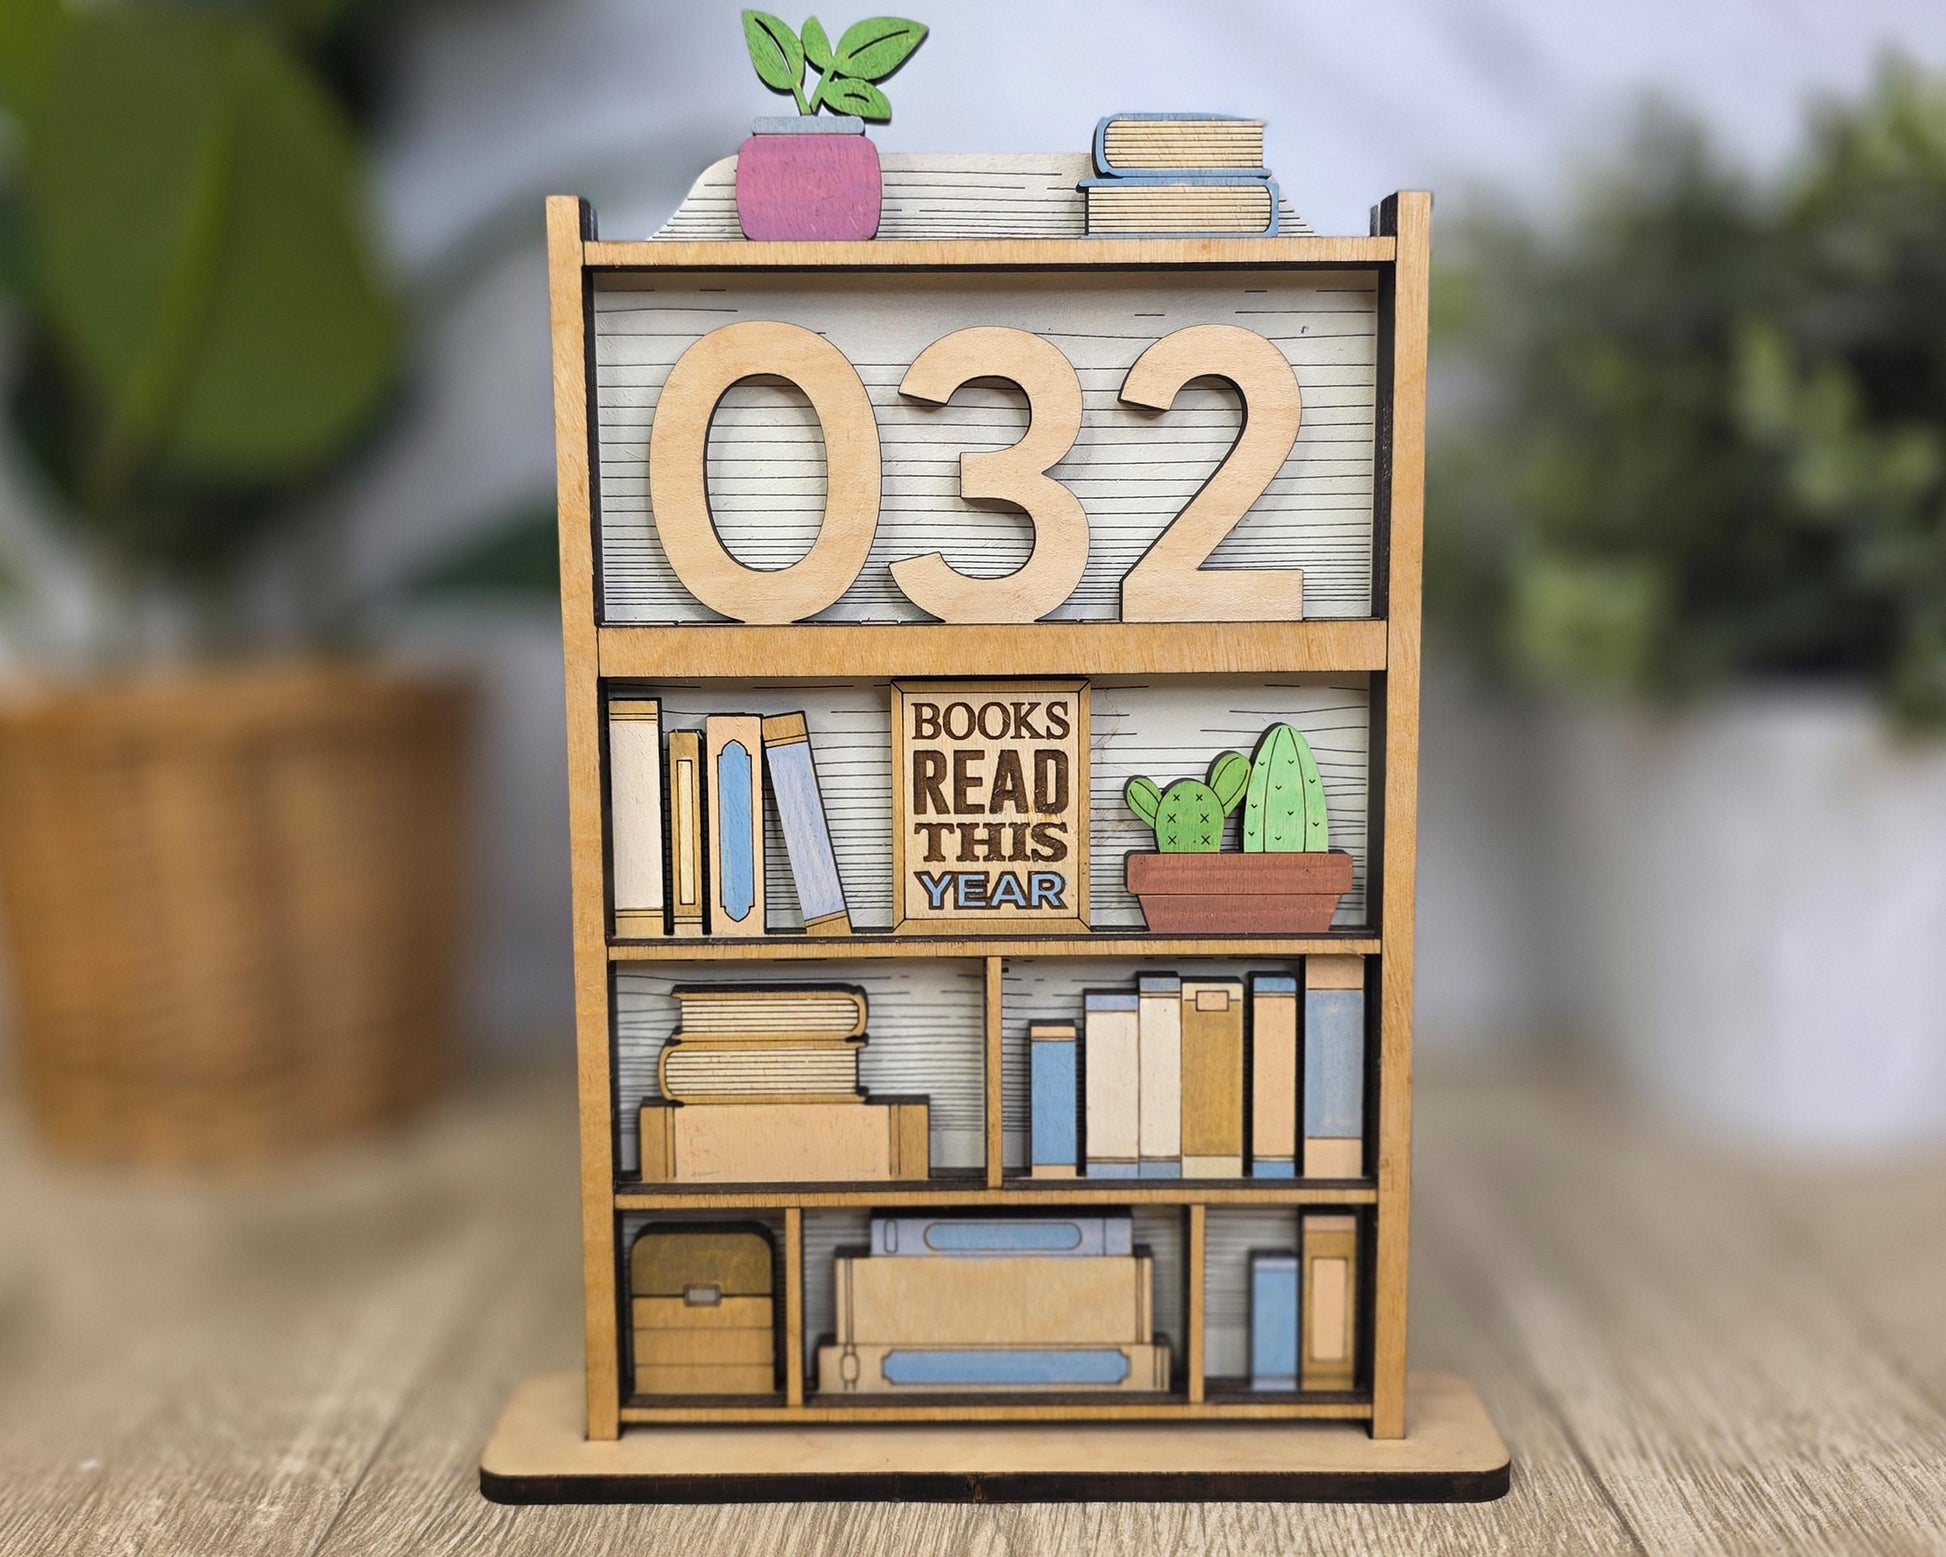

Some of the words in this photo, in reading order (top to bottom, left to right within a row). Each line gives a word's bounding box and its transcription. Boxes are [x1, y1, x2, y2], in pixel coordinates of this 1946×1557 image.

[649, 320, 1303, 624] 032
[910, 701, 1071, 741] BOOKS
[913, 749, 1069, 815] READ
[914, 822, 1069, 863] THIS
[913, 870, 1069, 910] YEAR
